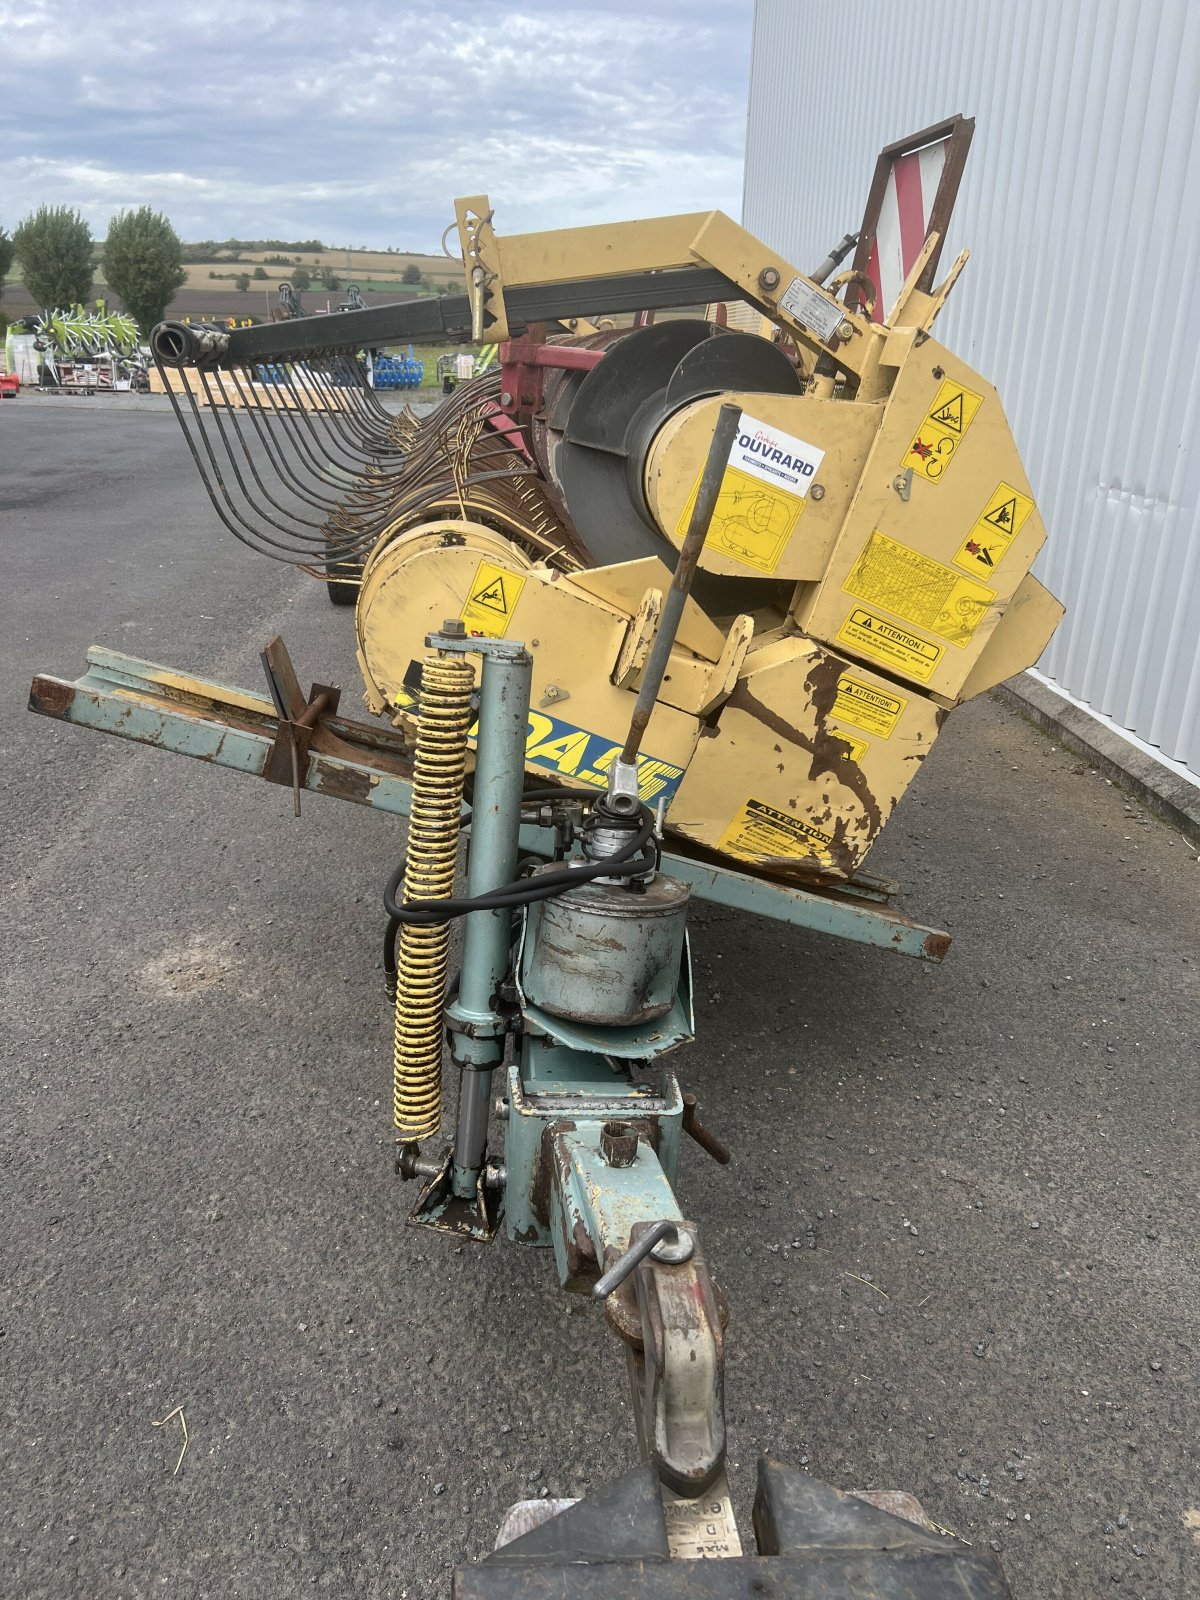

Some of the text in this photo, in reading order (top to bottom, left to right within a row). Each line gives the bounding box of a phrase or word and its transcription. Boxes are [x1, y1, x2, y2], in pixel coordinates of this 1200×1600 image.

[754, 431, 779, 448] Groupe
[877, 625, 926, 652] ATTENTION !
[853, 688, 892, 708] ATTENTION!
[757, 804, 833, 843] ATTENTION
